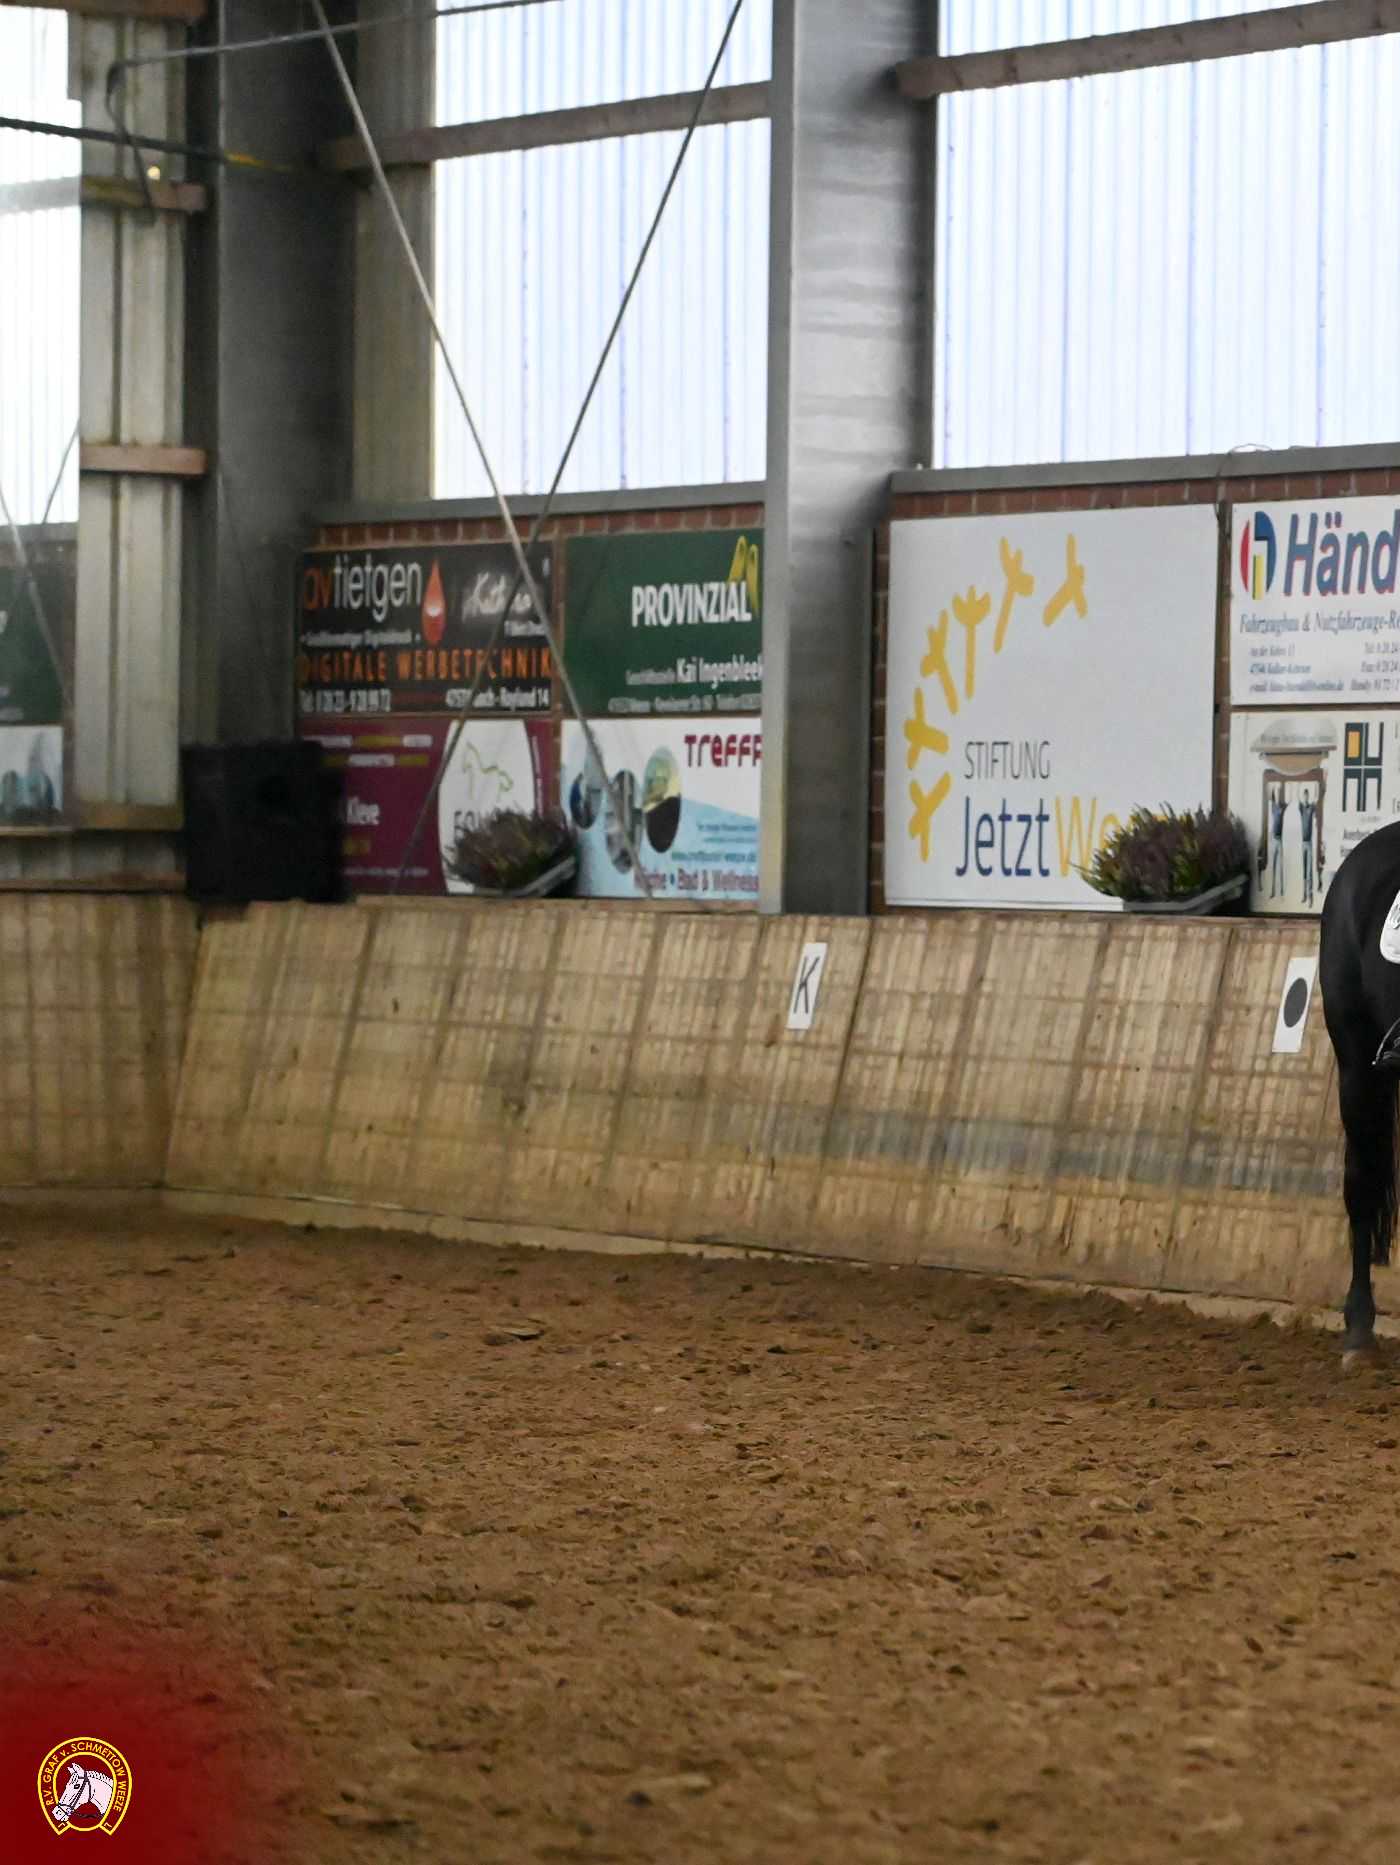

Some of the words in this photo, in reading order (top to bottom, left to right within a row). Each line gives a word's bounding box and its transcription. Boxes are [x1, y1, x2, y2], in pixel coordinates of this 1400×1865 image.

[631, 580, 752, 628] PROVINZIAL
[964, 740, 1050, 780] STIFTUNG
[794, 955, 820, 1015] K
